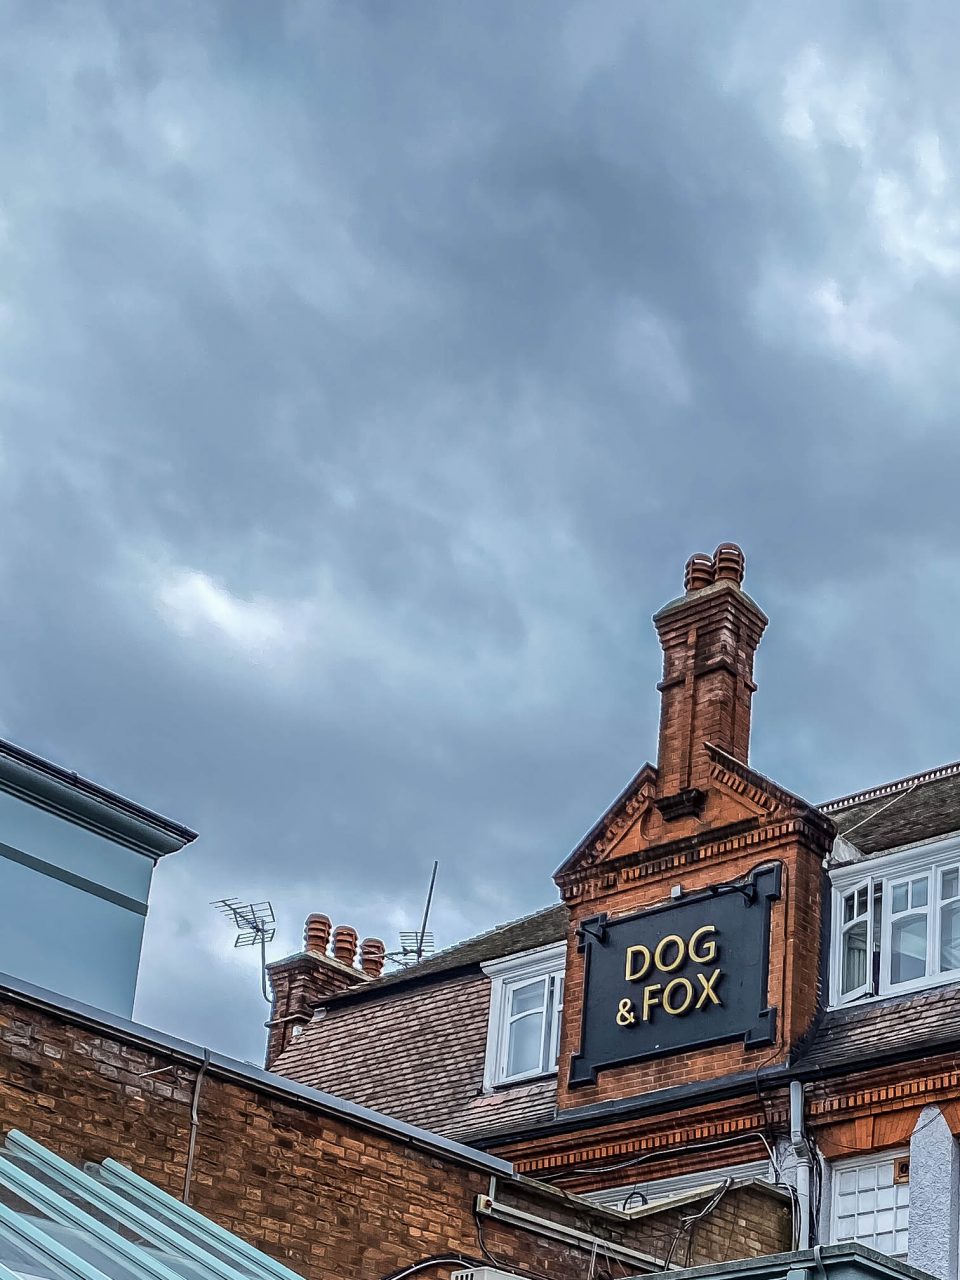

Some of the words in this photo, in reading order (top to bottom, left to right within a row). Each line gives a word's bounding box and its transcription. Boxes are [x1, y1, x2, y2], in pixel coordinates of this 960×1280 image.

[625, 925, 716, 981] DOG
[615, 998, 636, 1026] &
[642, 968, 722, 1021] FOX
